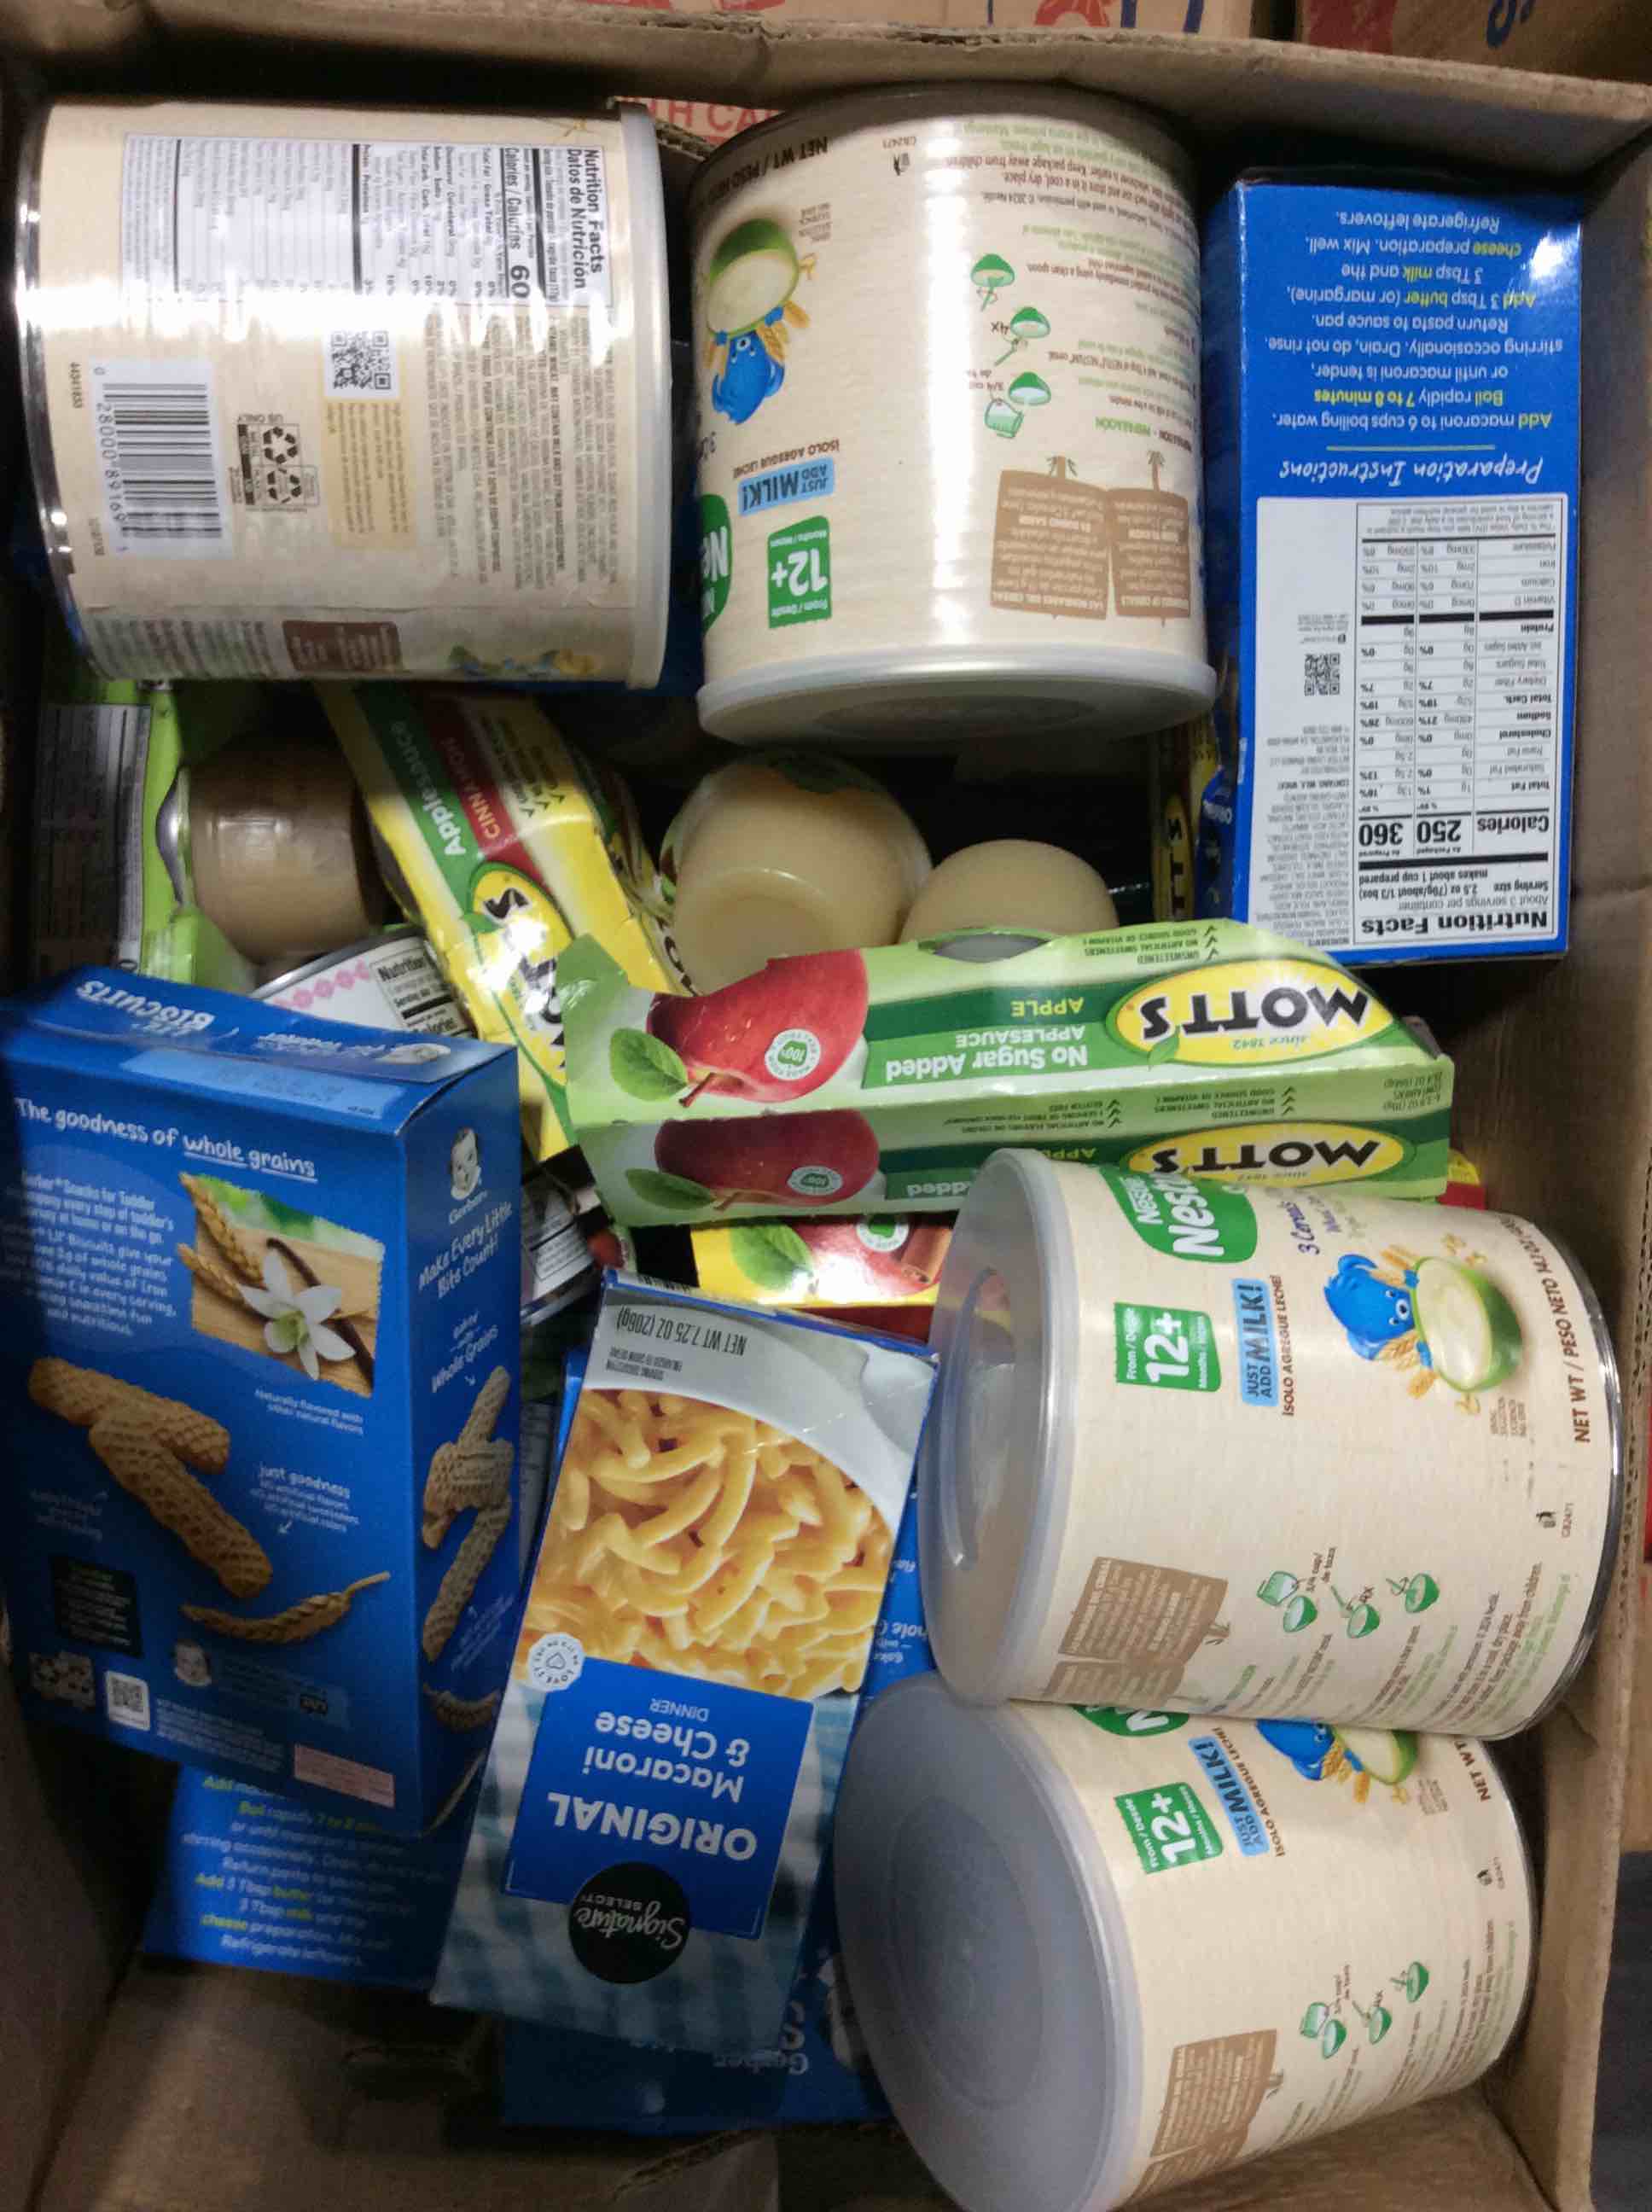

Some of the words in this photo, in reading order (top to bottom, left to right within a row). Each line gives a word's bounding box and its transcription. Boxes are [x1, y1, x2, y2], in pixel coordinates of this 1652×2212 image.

[504, 148, 521, 186] Calories
[567, 148, 583, 183] Datos
[585, 149, 602, 212] Nutrition
[570, 188, 585, 205] de
[1335, 211, 1410, 232] leftovers.
[1413, 212, 1499, 235] Refrigerate
[572, 208, 590, 288] Nutrición
[588, 220, 605, 273] Facts
[1306, 237, 1339, 254] well.
[1343, 238, 1370, 255] Mix
[1376, 235, 1469, 255] preparation.
[1474, 242, 1521, 258] cheese
[1341, 263, 1365, 280] the
[1370, 265, 1399, 280] and
[1403, 265, 1433, 282] milk
[1435, 263, 1469, 283] Tbsp
[1475, 266, 1483, 284] 3
[510, 265, 530, 298] 60
[1287, 284, 1376, 302] margarine),
[1380, 288, 1400, 306] (or
[1405, 292, 1448, 308] butter
[1451, 288, 1486, 308] Tbsp
[1491, 294, 1499, 308] 3
[1502, 292, 1537, 307] Add
[1312, 311, 1344, 329] pan.
[1347, 314, 1389, 329] sauce
[1393, 316, 1408, 331] to
[1412, 312, 1453, 332] pasta
[1457, 316, 1508, 333] Return
[1265, 336, 1302, 352] rinse.
[1306, 339, 1330, 354] not
[1334, 340, 1352, 354] do
[1355, 338, 1400, 356] Drain,
[1405, 338, 1500, 356] occasionally.
[1505, 338, 1562, 355] stirring
[1311, 363, 1363, 379] tender,
[1367, 365, 1376, 380] is
[1380, 365, 1451, 380] macaroni
[1455, 366, 1486, 381] until
[1491, 366, 1508, 379] or
[1314, 389, 1371, 405] minutes
[1375, 391, 1385, 406] 8
[1389, 391, 1402, 405] to
[1406, 391, 1415, 406] 7
[1418, 387, 1471, 406] rapidly
[1474, 389, 1503, 405] Boil
[1272, 414, 1318, 428] water.
[1321, 412, 1369, 429] boiling
[1371, 410, 1405, 428] cups
[1409, 416, 1417, 429] 6
[1421, 416, 1436, 428] to
[1440, 413, 1514, 428] macaroni
[1518, 413, 1552, 428] Add
[801, 464, 827, 479] ADD
[1280, 457, 1406, 486] Instructions
[1413, 452, 1543, 484] Preparation
[742, 471, 798, 512] MILK!
[801, 478, 828, 494] JUST
[771, 548, 829, 597] 12+
[1416, 819, 1462, 844] 250
[1477, 815, 1550, 834] Calories
[1359, 823, 1403, 847] 360
[1359, 873, 1399, 887] prepared
[1403, 872, 1418, 883] cup
[1422, 873, 1425, 882] 1
[1430, 870, 1455, 882] about
[1457, 869, 1488, 880] makes
[1358, 888, 1379, 900] box)
[1382, 888, 1394, 899] 1/3
[1451, 885, 1461, 894] oz
[1463, 883, 1478, 894] 2.5
[1494, 882, 1510, 893] size
[1514, 879, 1549, 892] Serving
[1399, 900, 1443, 911] container
[1448, 899, 1463, 910] per
[1465, 896, 1507, 909] servings
[1510, 898, 1516, 908] 3
[1520, 896, 1548, 907] About
[1361, 918, 1428, 935] Facts
[1438, 911, 1548, 930] Nutrition
[1137, 949, 1200, 964] UNSWEETENED
[76, 980, 216, 1033] BISCUITS
[1010, 997, 1085, 1017] APPLE
[1137, 982, 1370, 1051] MOTT'S
[955, 1027, 1086, 1048] APPLESAUCE
[1232, 1037, 1264, 1050] 1842
[1270, 1035, 1309, 1046] since
[972, 1045, 1045, 1073] Sugar
[1050, 1045, 1087, 1067] No
[885, 1055, 969, 1080] Added
[15, 1097, 52, 1122] The
[55, 1109, 148, 1143] goodness
[152, 1126, 179, 1146] of
[183, 1134, 245, 1161] whole
[248, 1150, 317, 1179] grains
[1149, 1138, 1381, 1178] MOTT'S
[1543, 1278, 1567, 1315] NETO
[616, 1307, 655, 1336] (206g)
[655, 1318, 674, 1339] OZ
[1238, 1285, 1270, 1362] MILK!
[675, 1322, 701, 1346] 7.25
[702, 1329, 722, 1350] WT
[1556, 1318, 1579, 1358] PESO
[724, 1333, 747, 1356] NET
[1143, 1313, 1190, 1382] 12+
[1278, 1313, 1293, 1374] AGREGUE
[1566, 1361, 1584, 1371] /
[1248, 1363, 1259, 1397] JUST
[1260, 1365, 1271, 1398] ADD
[1568, 1374, 1586, 1402] WT
[1573, 1408, 1591, 1443] NET
[649, 1698, 709, 1721] DINNER
[594, 1710, 718, 1760] Cheese
[725, 1738, 751, 1767] &
[1454, 1740, 1475, 1767] WT
[582, 1746, 744, 1803] Macaroni
[1194, 1741, 1249, 1812] MILK!
[1239, 1761, 1270, 1816] AGREGUE
[1469, 1771, 1491, 1802] NET
[547, 1791, 757, 1860] ORIGINAL
[1150, 1792, 1195, 1863] 12+
[1235, 1815, 1252, 1847] JUST
[1246, 1815, 1263, 1845] ADD
[573, 1901, 686, 1949] Signature
